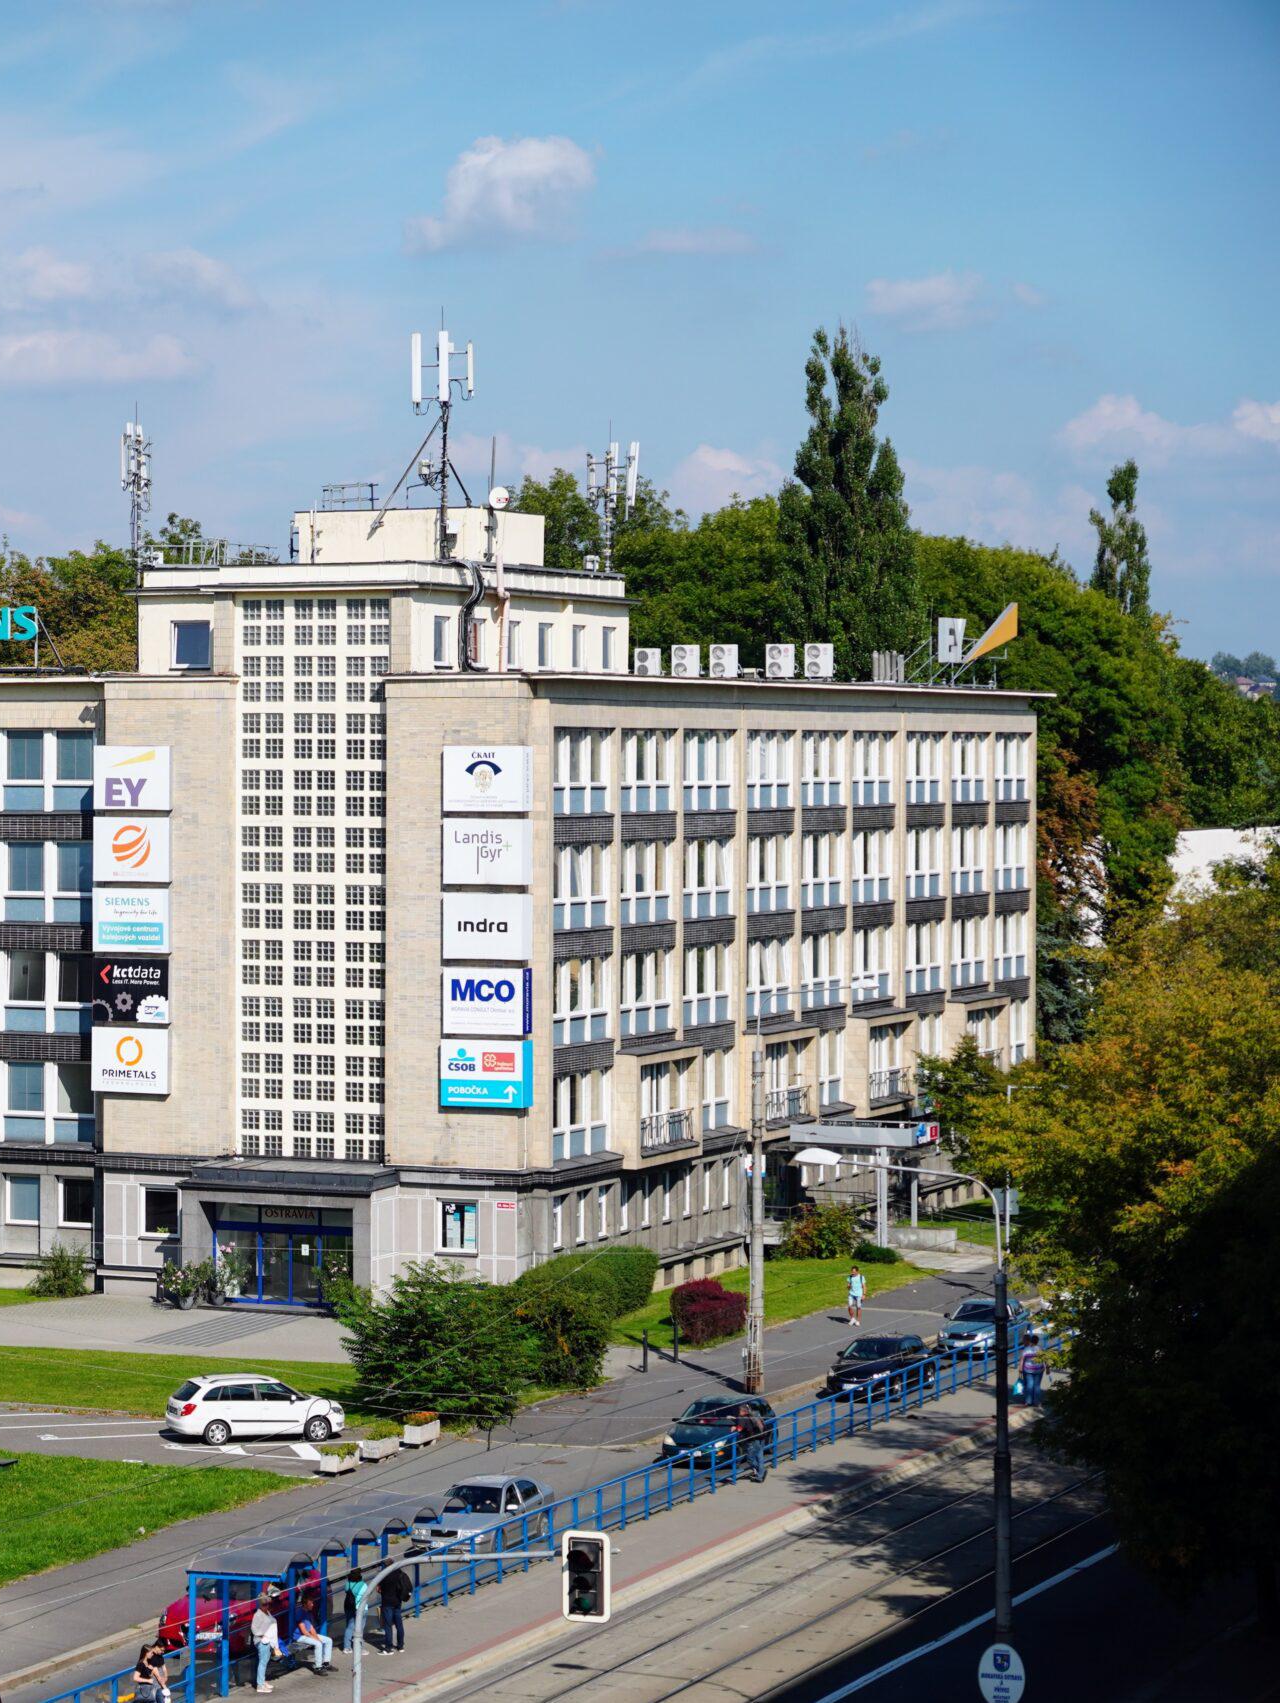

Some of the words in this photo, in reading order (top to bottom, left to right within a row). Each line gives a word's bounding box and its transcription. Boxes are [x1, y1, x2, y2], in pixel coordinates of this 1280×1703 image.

[105, 777, 147, 807] EY
[454, 830, 503, 844] Landis
[105, 897, 150, 906] SIEMENS
[458, 918, 508, 933] indra
[112, 965, 161, 979] kctdata
[451, 979, 516, 1002] MCO
[448, 1062, 476, 1072] ČSOB
[102, 1069, 157, 1080] PRIMETALS
[448, 1085, 489, 1095] POBOČKA
[264, 1207, 315, 1219] OSTRAVIA
